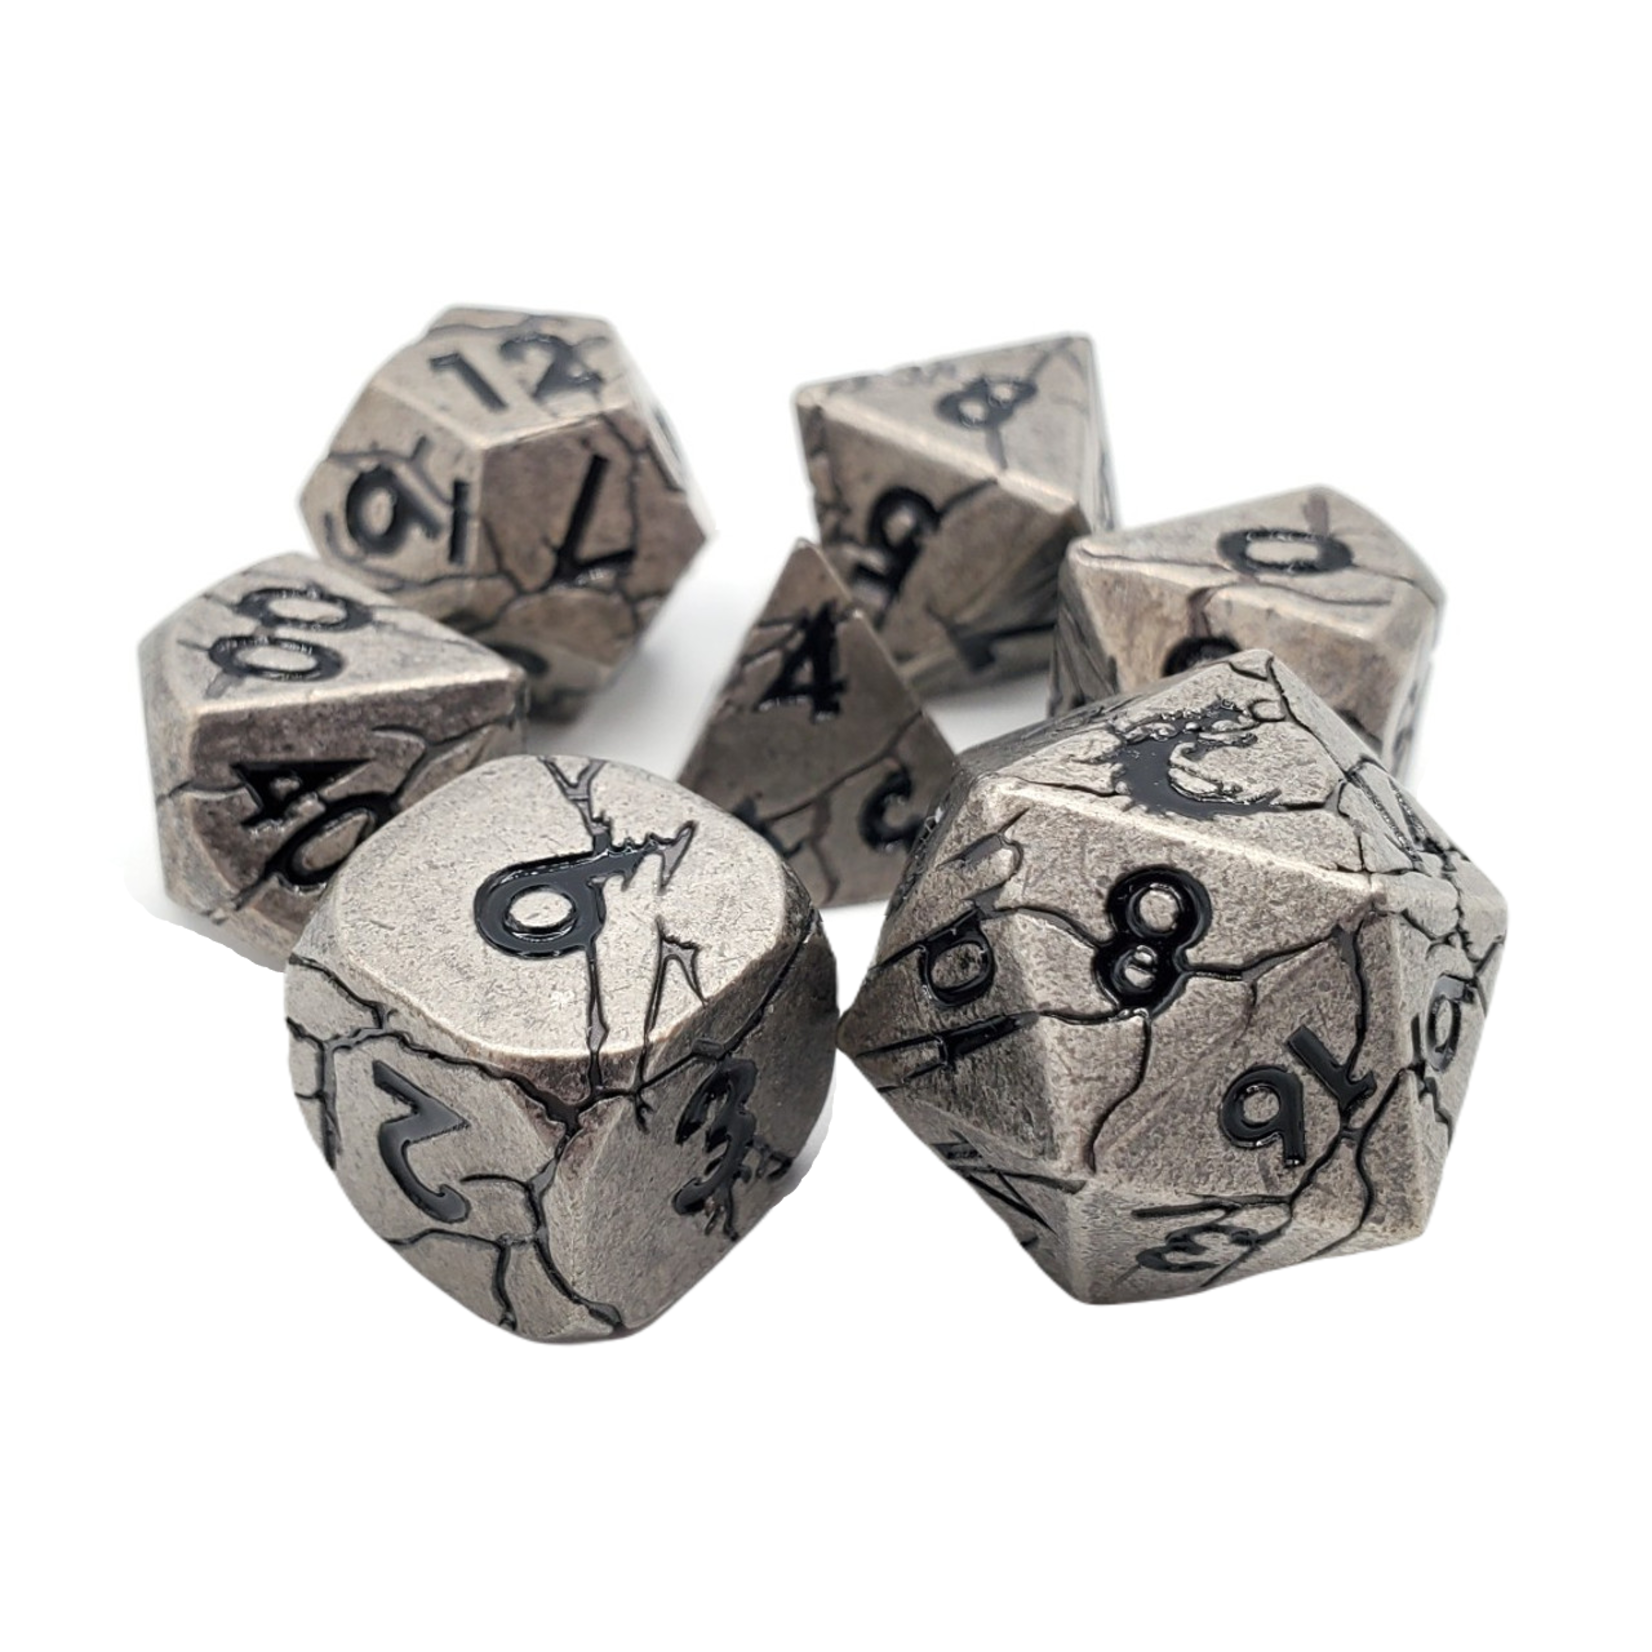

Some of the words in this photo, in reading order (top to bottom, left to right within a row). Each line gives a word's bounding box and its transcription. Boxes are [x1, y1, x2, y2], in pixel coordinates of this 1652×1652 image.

[429, 331, 604, 412] 12
[936, 373, 1038, 431] 8
[1217, 527, 1352, 578] 0
[755, 602, 847, 723] 4
[1094, 864, 1213, 1008] 8
[373, 1059, 470, 1224] 2
[674, 1057, 758, 1216] 3
